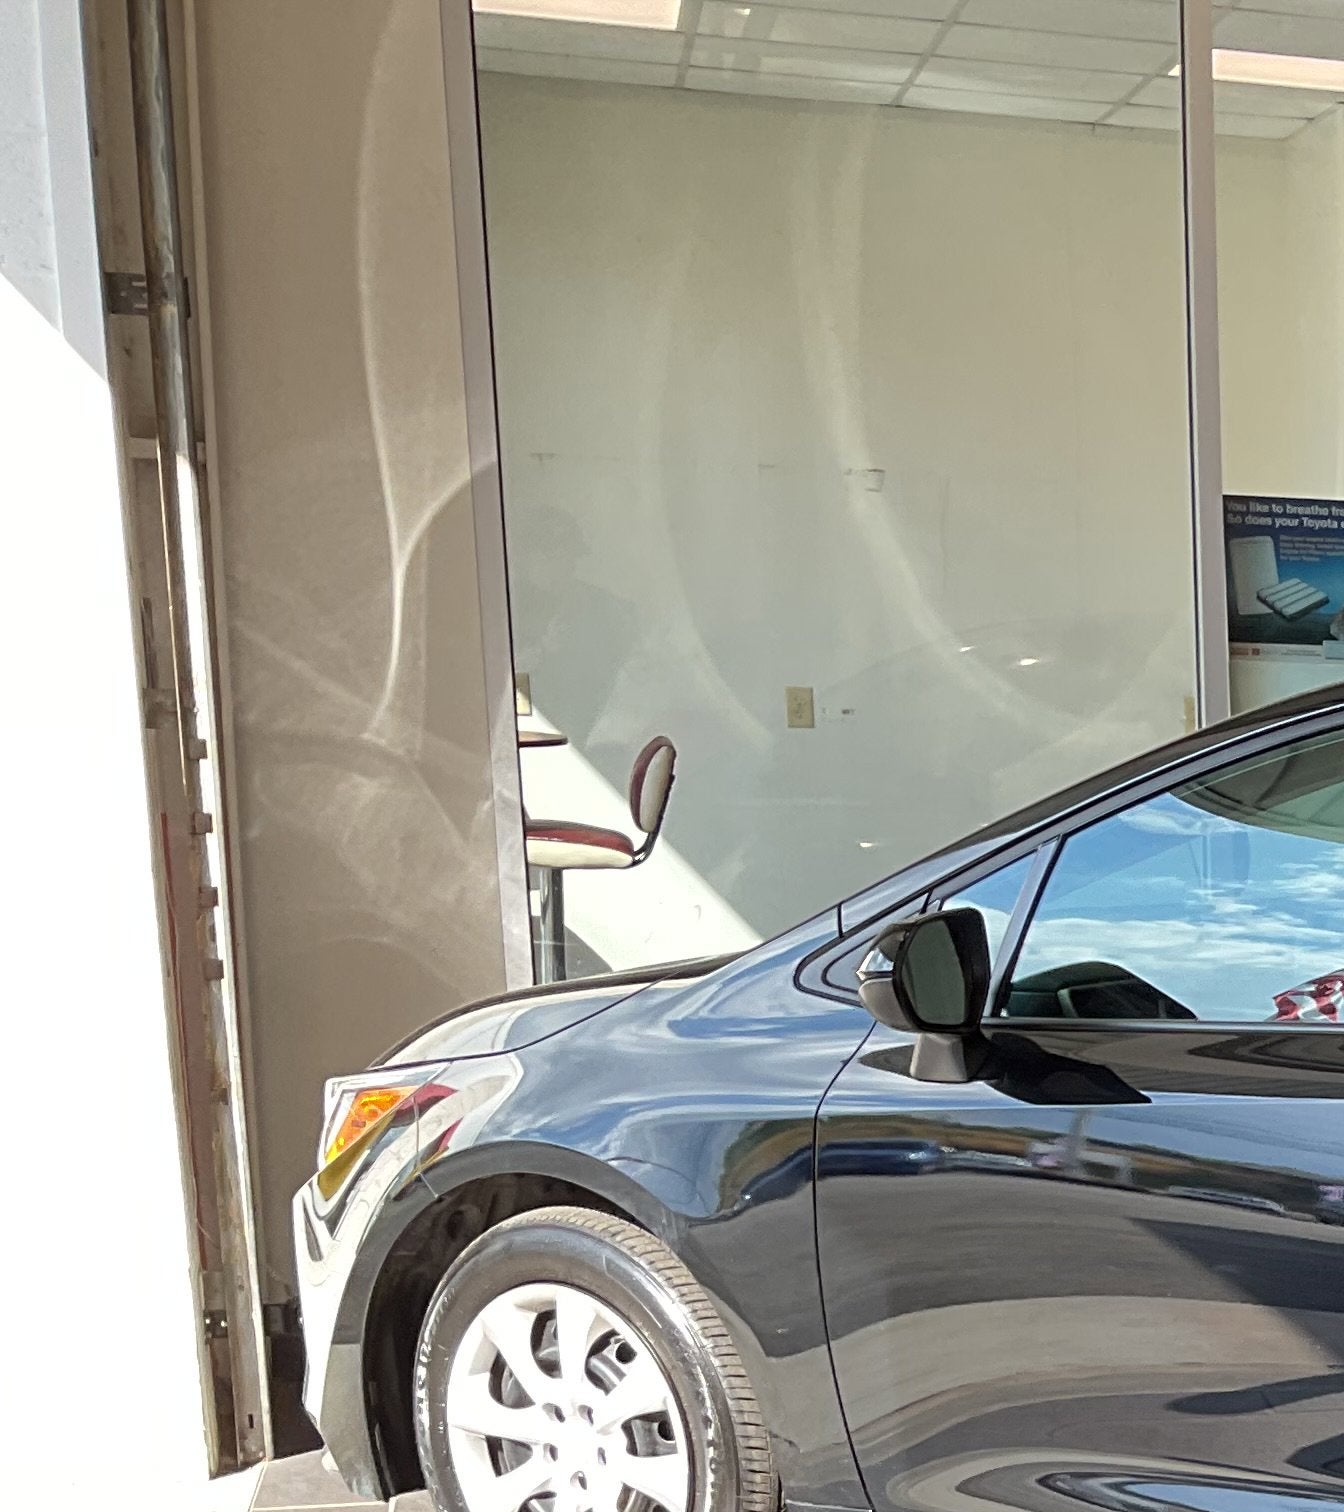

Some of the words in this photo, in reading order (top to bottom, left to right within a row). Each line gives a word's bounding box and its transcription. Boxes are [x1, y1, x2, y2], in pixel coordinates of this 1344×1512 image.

[1272, 504, 1284, 514] to
[1286, 504, 1329, 516] breathe
[1245, 514, 1273, 526] does
[1275, 517, 1299, 528] your
[1301, 516, 1338, 530] Toyota
